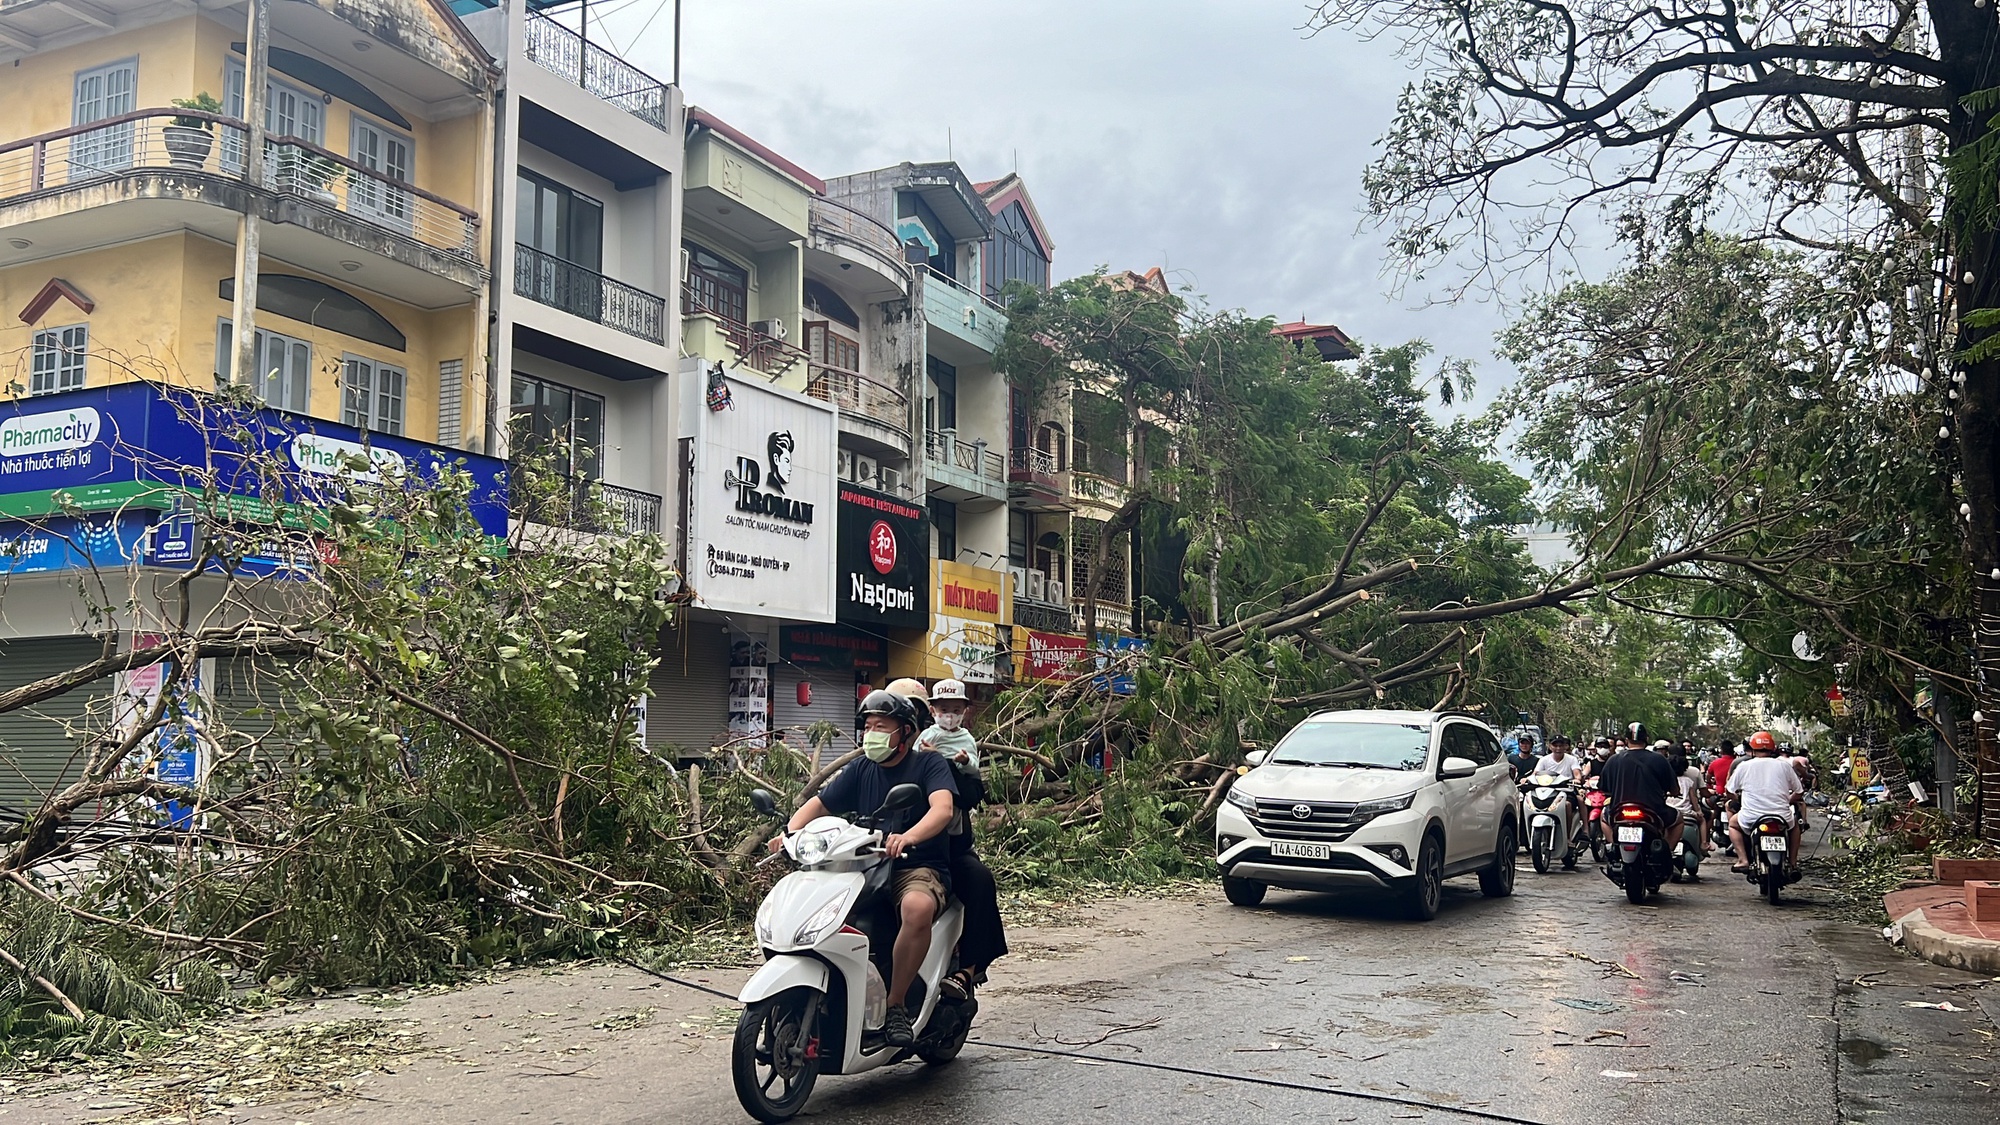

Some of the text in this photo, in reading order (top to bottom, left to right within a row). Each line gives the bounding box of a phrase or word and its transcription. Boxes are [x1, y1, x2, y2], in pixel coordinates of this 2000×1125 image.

[3, 419, 93, 449] Pharmacity
[1, 458, 23, 475] Nhà
[24, 453, 55, 472] thuốc
[78, 449, 92, 468] lợi
[840, 490, 920, 520] JAPANESE RESTAURANT
[725, 515, 811, 541] SALON TÓC NAM CHUYÊN NGHIỆP
[876, 527, 891, 556] 和
[736, 553, 748, 564] CAO
[782, 561, 790, 571] HP
[851, 572, 914, 614] Nagomi
[945, 580, 963, 608] MÁT
[963, 587, 975, 611] XA
[938, 686, 957, 695] Dior
[1274, 843, 1327, 859] 14A-406.81
